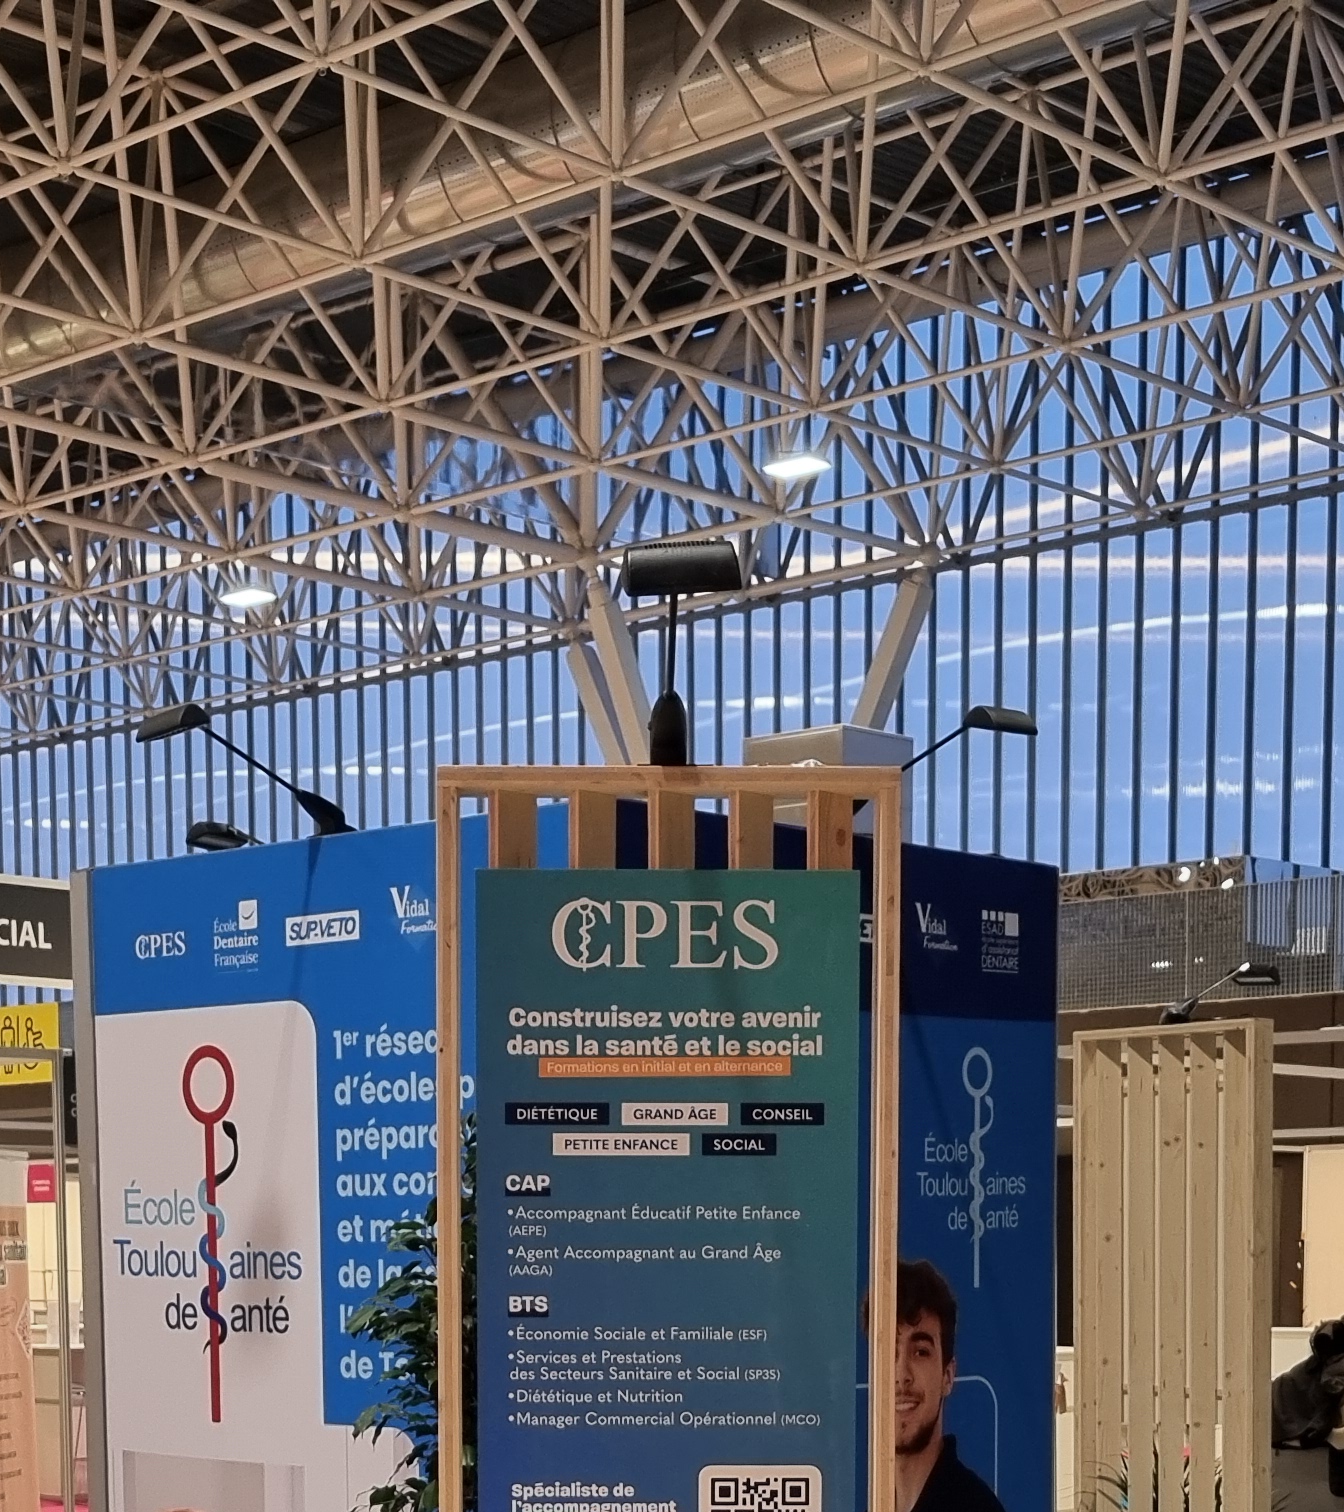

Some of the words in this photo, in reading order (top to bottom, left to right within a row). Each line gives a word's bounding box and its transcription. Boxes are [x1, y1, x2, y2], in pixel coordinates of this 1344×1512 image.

[389, 885, 429, 918] Vidal
[214, 917, 237, 933] École
[915, 902, 946, 935] Vidal
[551, 897, 779, 971] CPES
[981, 921, 1004, 935] ESAD
[135, 931, 186, 960] CPES
[214, 932, 258, 950] Dentaire
[923, 936, 958, 951] Formation
[214, 950, 258, 968] Française
[981, 955, 1018, 969] DENTAIRE
[509, 1006, 662, 1028] Construisez
[669, 1009, 734, 1028] votre
[742, 1006, 821, 1028] avenir
[507, 1035, 569, 1056] dans
[576, 1035, 597, 1056] la
[605, 1034, 678, 1056] santé
[685, 1038, 710, 1056] et
[718, 1035, 740, 1056] le
[747, 1034, 823, 1056] social
[547, 1061, 618, 1073] Formations
[622, 1064, 638, 1073] en
[641, 1060, 676, 1073] initial
[678, 1062, 692, 1073] et
[694, 1063, 710, 1072] en
[713, 1061, 783, 1072] alternance
[334, 1071, 437, 1105] d'école
[516, 1106, 598, 1121] DIÉTÉTIQUE
[633, 1108, 684, 1120] GRAND
[688, 1105, 717, 1120] ÂGE
[752, 1108, 813, 1120] CONSEIL
[564, 1138, 610, 1151] PETITE
[614, 1138, 678, 1151] ENFANCE
[713, 1138, 765, 1151] SOCIAL
[336, 1172, 387, 1197] aux
[506, 1174, 550, 1192] CAP
[515, 1207, 626, 1222] Accompagnant
[631, 1203, 691, 1220] Éducatif
[696, 1206, 737, 1220] Petite
[742, 1206, 800, 1220] Enfance
[948, 1207, 968, 1230] de
[337, 1215, 363, 1243] et
[508, 1225, 547, 1238] (AEPE)
[516, 1246, 559, 1262] Agent
[564, 1246, 674, 1262] Accompagnant
[680, 1250, 696, 1260] au
[701, 1246, 748, 1260] Grand
[753, 1242, 781, 1262] Âge
[338, 1259, 371, 1288] de
[509, 1264, 553, 1278] (AAGA)
[165, 1293, 198, 1331] de
[508, 1296, 548, 1313] BTS
[516, 1324, 589, 1341] Économie
[594, 1327, 646, 1341] Sociale
[651, 1328, 665, 1341] et
[670, 1327, 733, 1341] Familiale
[738, 1329, 767, 1342] (ESF)
[340, 1350, 373, 1379] de
[516, 1350, 577, 1364] Services
[582, 1352, 596, 1364] et
[601, 1350, 682, 1364] Prestations
[509, 1367, 535, 1381] des
[540, 1367, 604, 1381] Secteurs
[609, 1367, 672, 1380] Sanitaire
[677, 1368, 692, 1380] et
[696, 1367, 740, 1380] Social
[744, 1368, 781, 1381] (SP3S)
[516, 1389, 592, 1406] Diététique
[598, 1391, 612, 1403] et
[617, 1390, 683, 1403] Nutrition
[517, 1412, 580, 1428] Manager
[585, 1412, 675, 1426] Commercial
[680, 1412, 776, 1428] Opérationnel
[781, 1413, 821, 1427] (MCO)
[511, 1481, 608, 1500] Spécialiste
[612, 1482, 634, 1497] de
